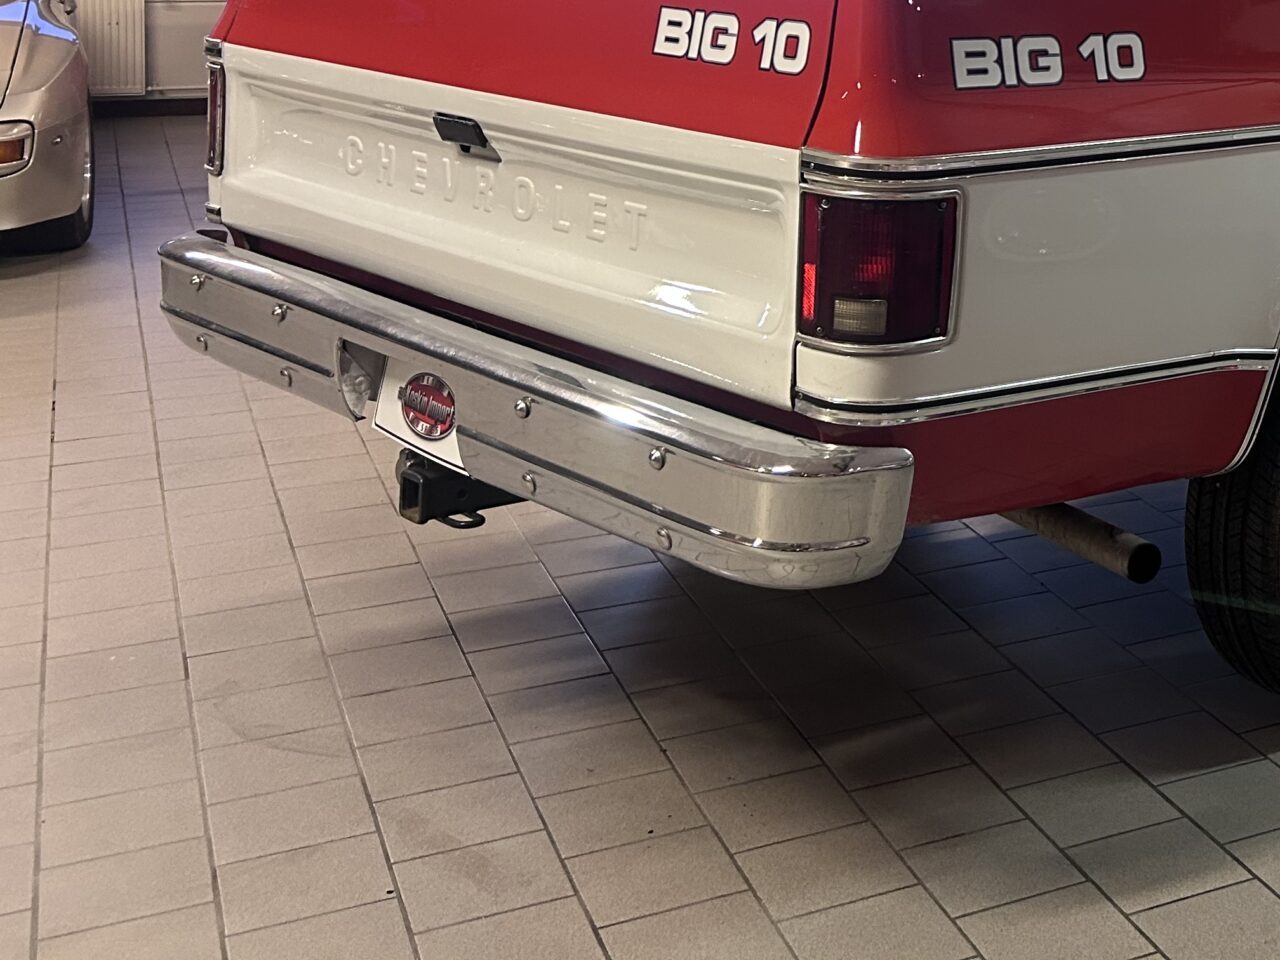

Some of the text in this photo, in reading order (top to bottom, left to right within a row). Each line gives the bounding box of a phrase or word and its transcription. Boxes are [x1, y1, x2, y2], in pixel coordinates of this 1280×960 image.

[653, 5, 811, 75] BIG 10
[950, 31, 1146, 89] BIG 10
[343, 135, 648, 251] CHEVROLET
